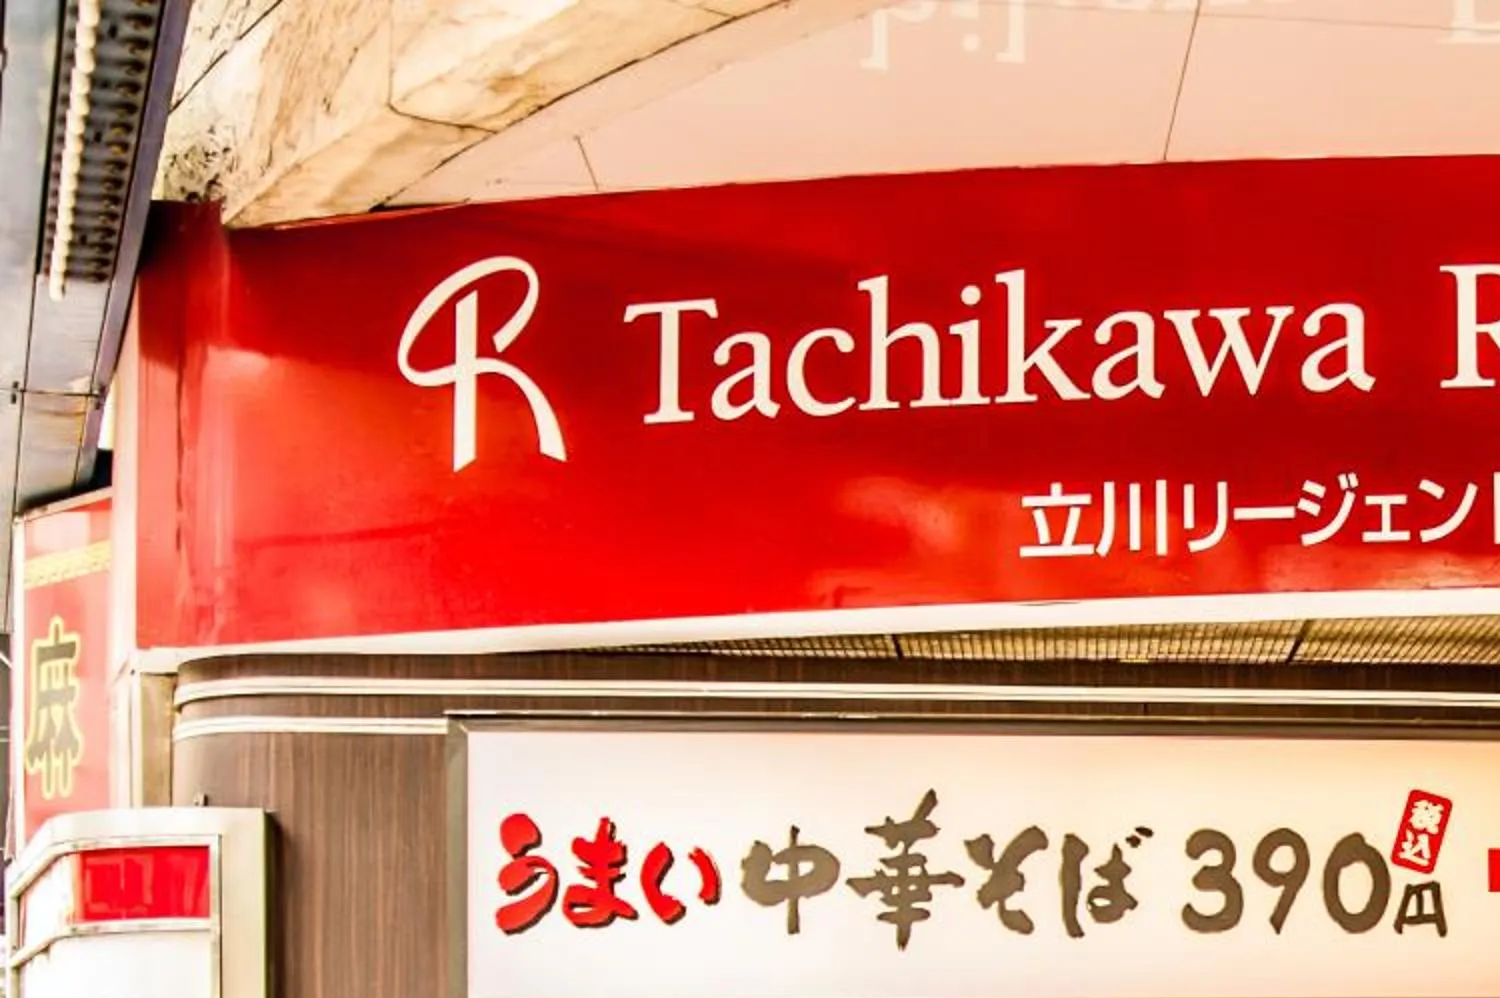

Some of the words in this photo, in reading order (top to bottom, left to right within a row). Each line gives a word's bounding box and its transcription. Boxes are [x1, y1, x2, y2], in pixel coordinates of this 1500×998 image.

[624, 269, 1376, 425] Tachikawa
[496, 812, 722, 935] うまい
[741, 788, 1153, 952] 中華そば
[1180, 826, 1447, 938] 390円
